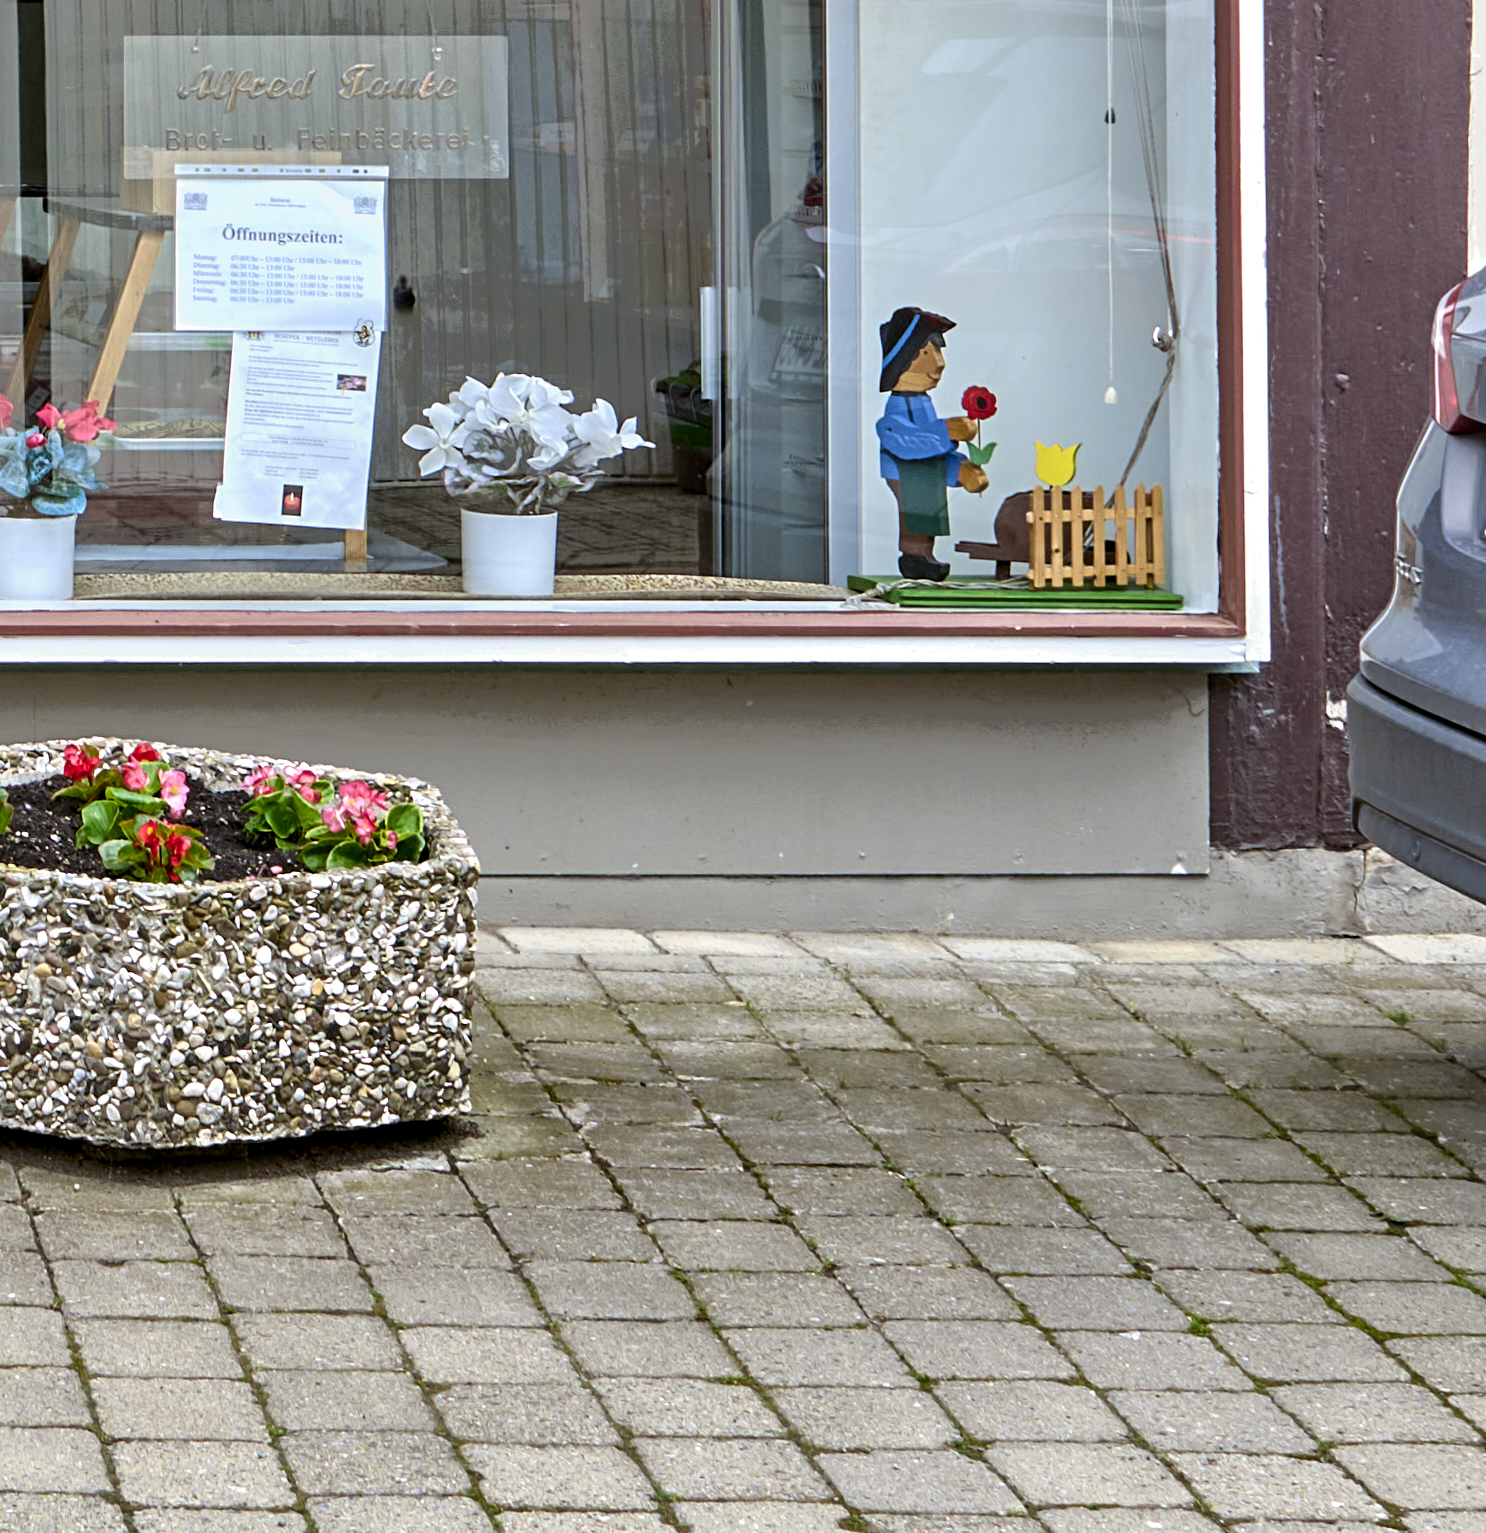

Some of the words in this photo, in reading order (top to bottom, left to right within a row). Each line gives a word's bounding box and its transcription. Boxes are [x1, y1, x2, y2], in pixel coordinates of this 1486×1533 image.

[176, 64, 317, 114] Alfred
[337, 63, 459, 100] Taute
[253, 133, 273, 152] u.
[297, 127, 471, 152] Feinbäckerei
[221, 223, 344, 246] Öffnungszeiten:
